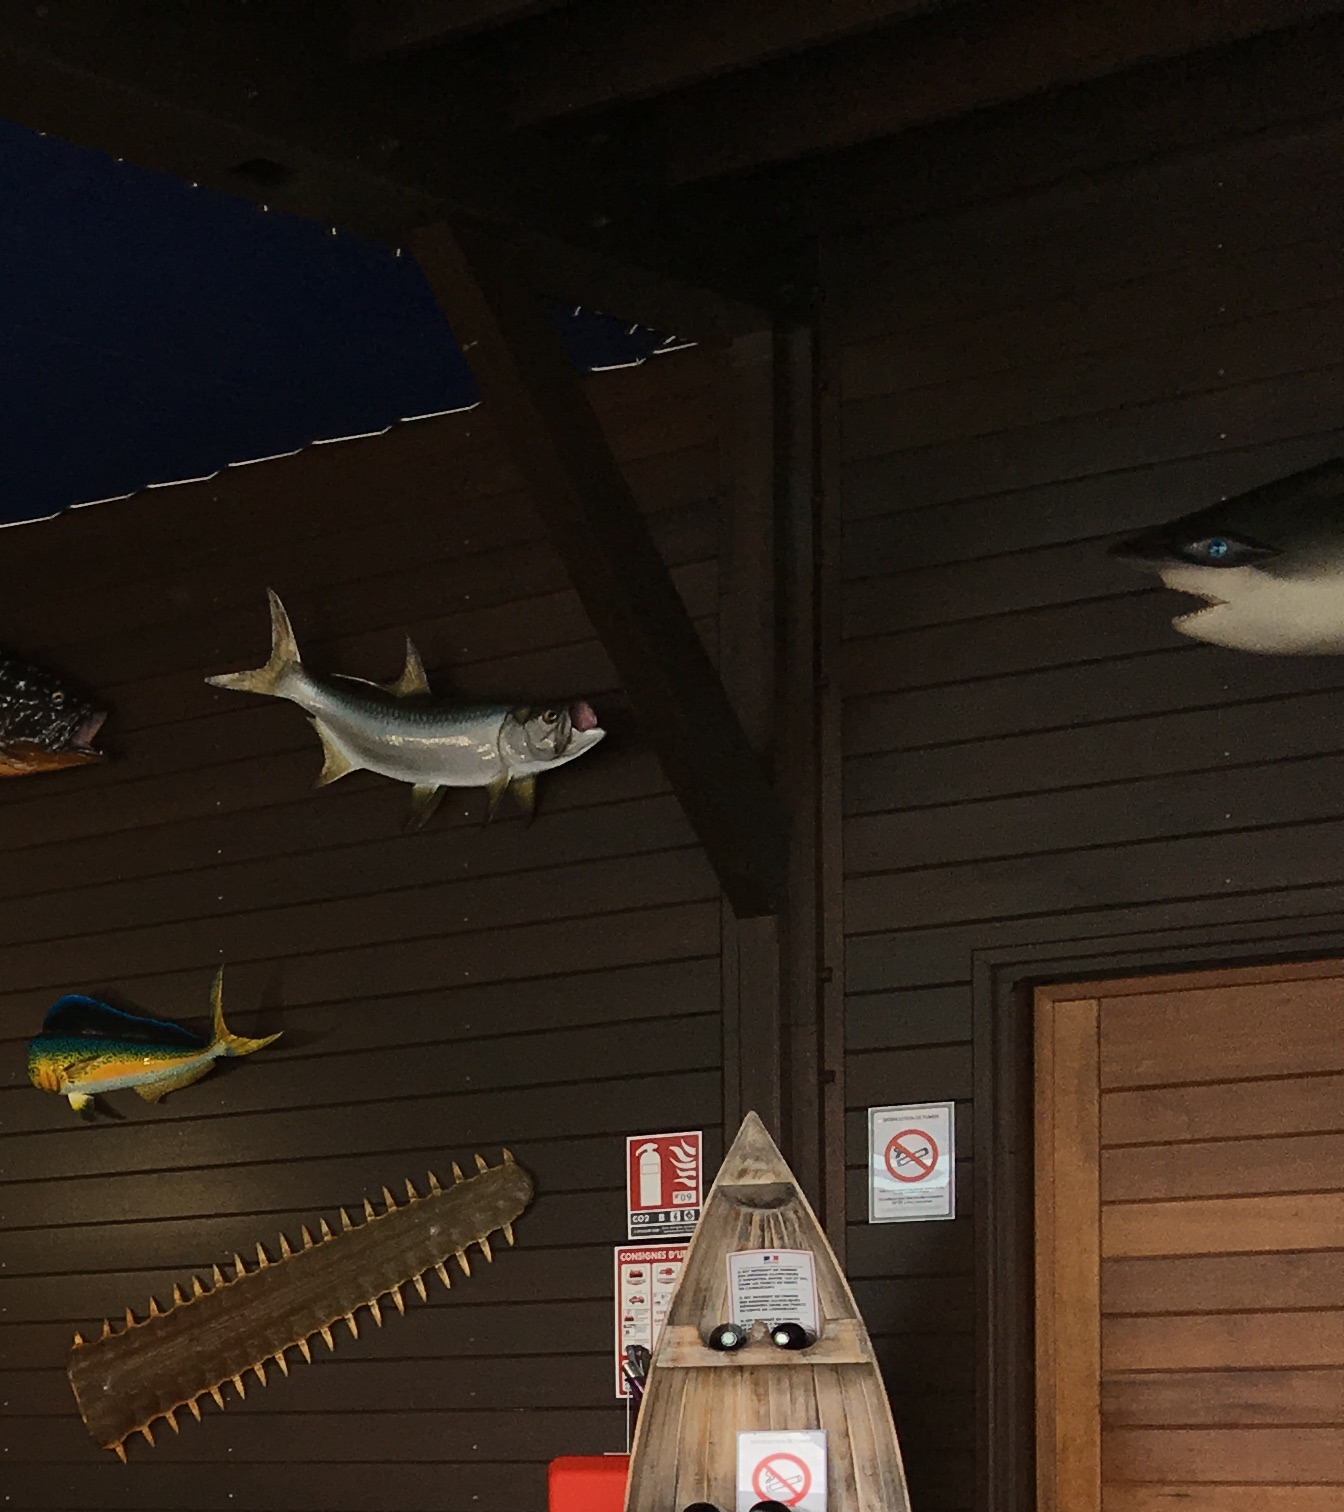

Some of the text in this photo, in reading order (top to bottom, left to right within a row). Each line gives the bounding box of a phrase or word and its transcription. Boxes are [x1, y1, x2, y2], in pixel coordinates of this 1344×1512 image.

[680, 1192, 693, 1202] 09
[632, 1214, 650, 1223] CO2
[619, 1250, 667, 1262] CONSIGNES
